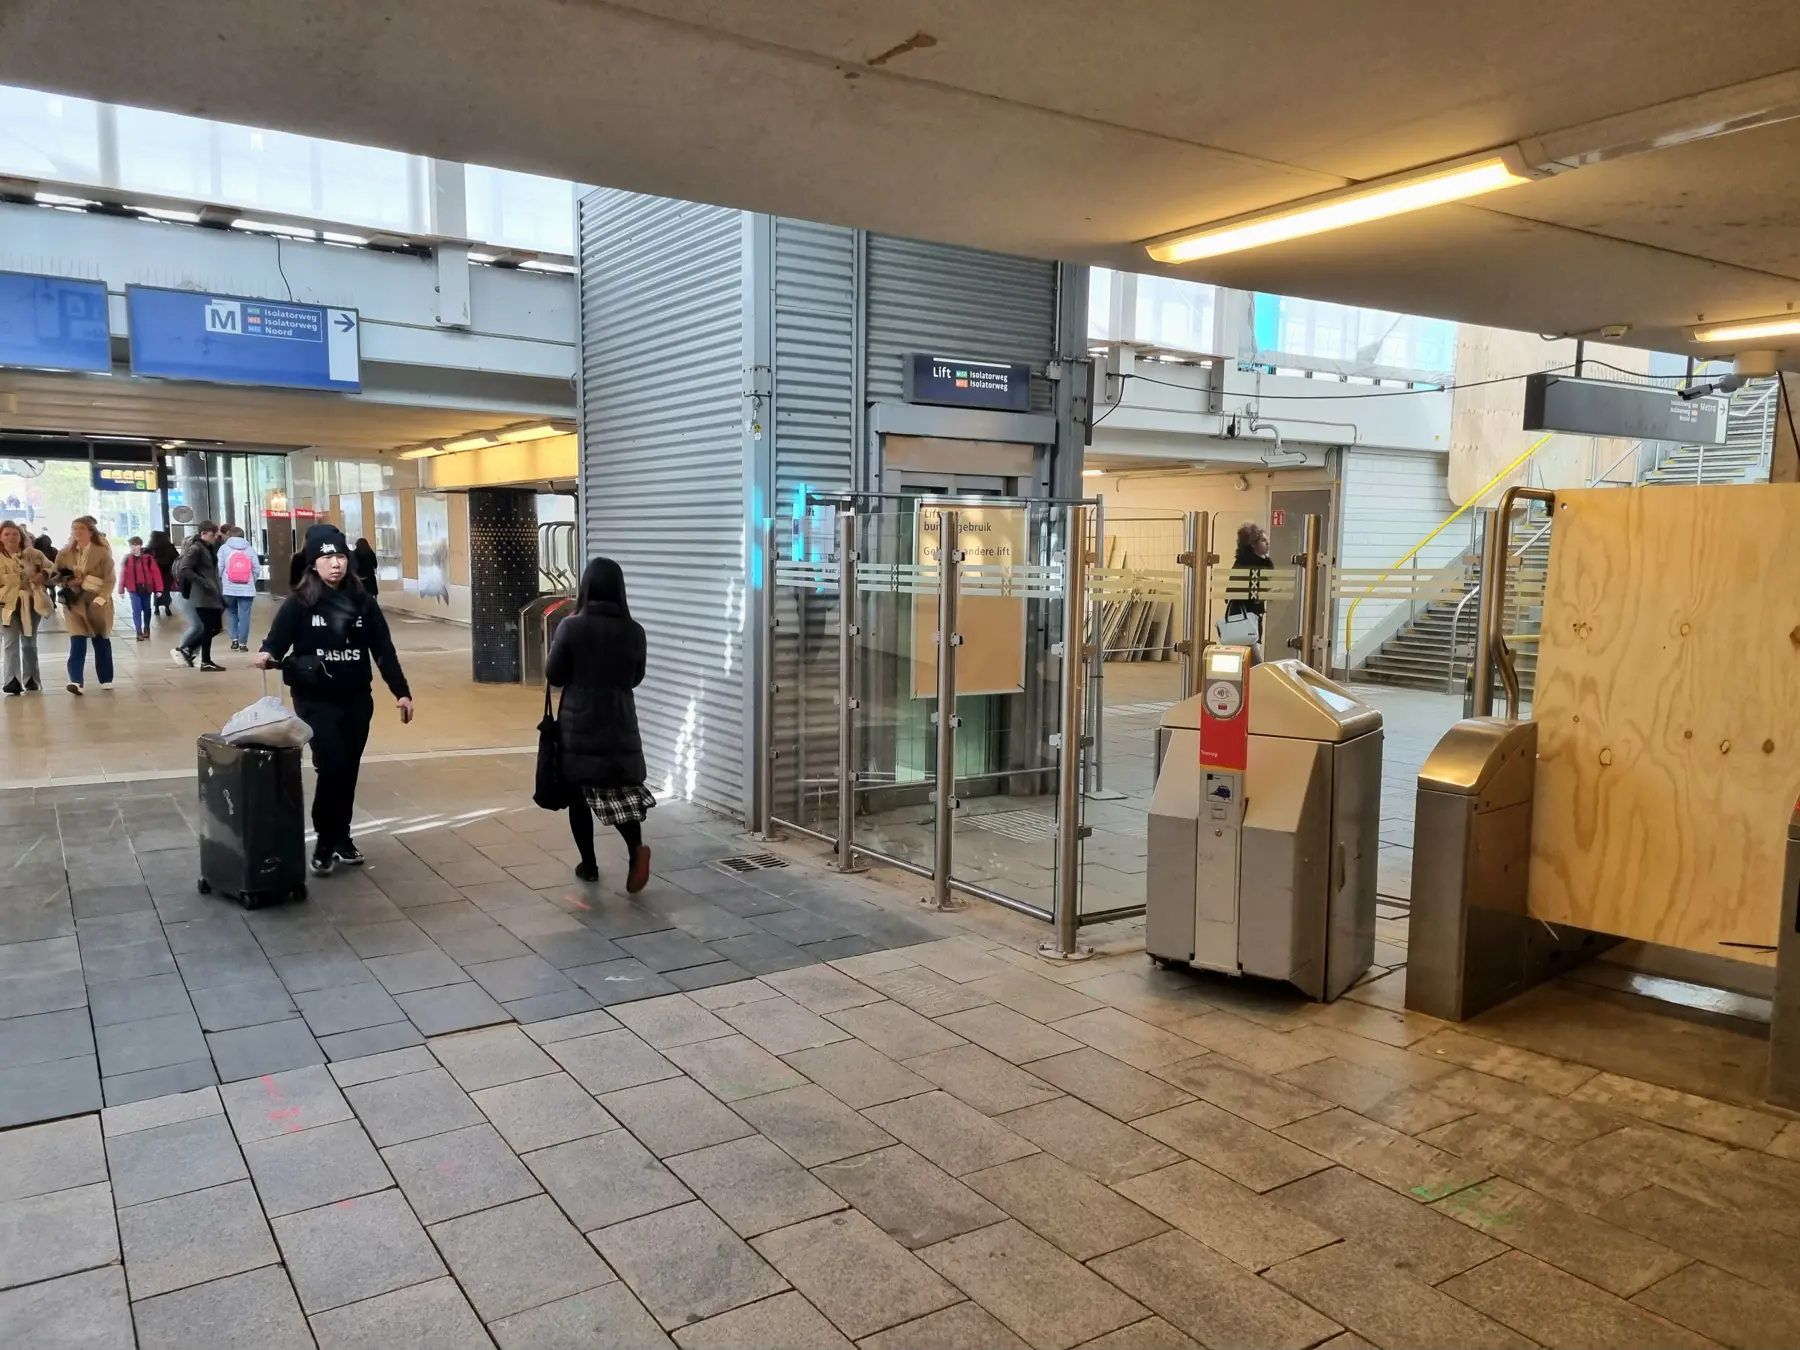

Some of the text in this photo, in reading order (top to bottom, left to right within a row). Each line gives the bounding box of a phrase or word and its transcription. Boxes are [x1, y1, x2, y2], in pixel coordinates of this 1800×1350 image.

[210, 308, 237, 331] M
[264, 308, 317, 323] Isolatorweg
[264, 317, 318, 332] Isolatorweg
[265, 326, 293, 336] Noord
[933, 366, 952, 379] Lift
[970, 371, 1008, 383] Isolatorweg
[970, 380, 1008, 392] Isolatorweg
[958, 522, 991, 533] gebruik
[963, 546, 1010, 556] andere lift
